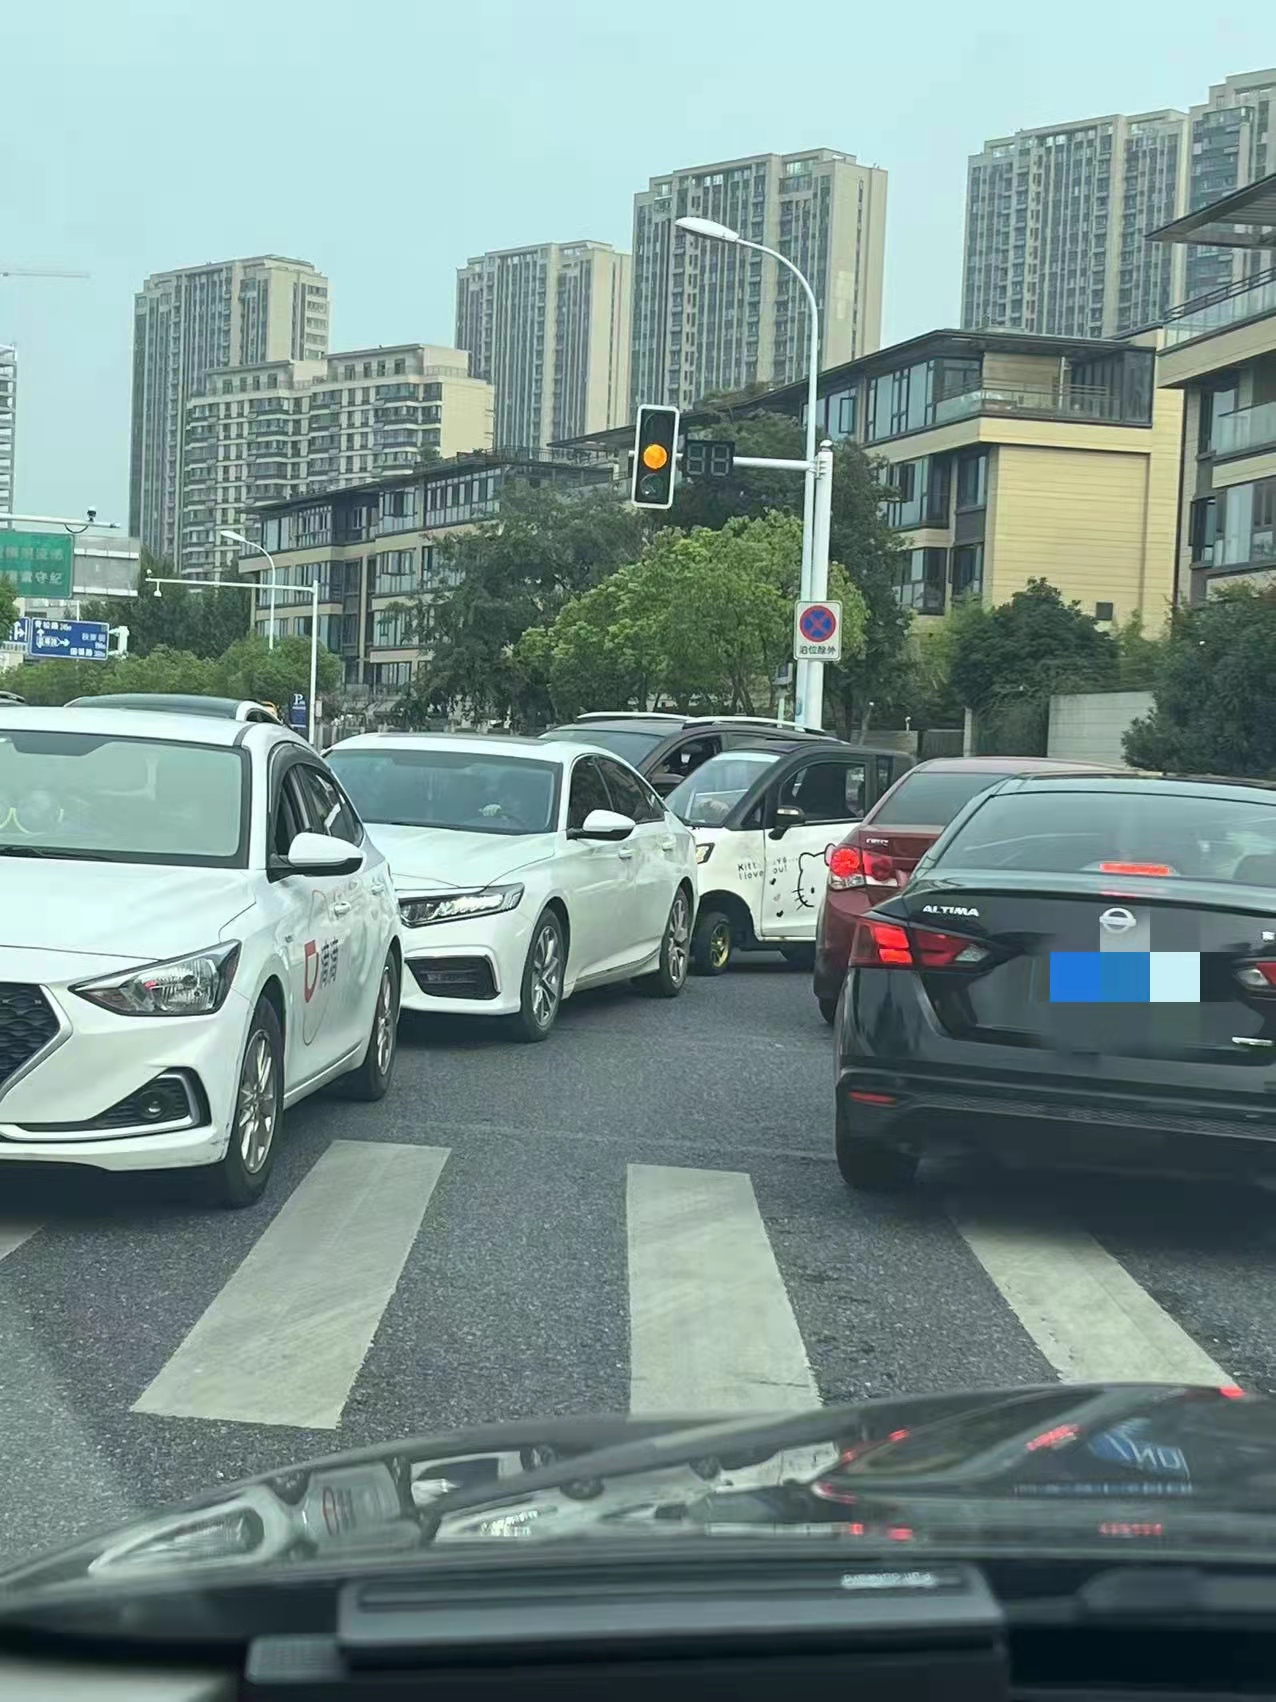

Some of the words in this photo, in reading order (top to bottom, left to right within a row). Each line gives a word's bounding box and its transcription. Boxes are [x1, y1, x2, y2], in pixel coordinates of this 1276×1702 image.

[799, 645, 836, 655] 泊位除外
[294, 693, 304, 705] P
[922, 904, 980, 917] ALTIMA
